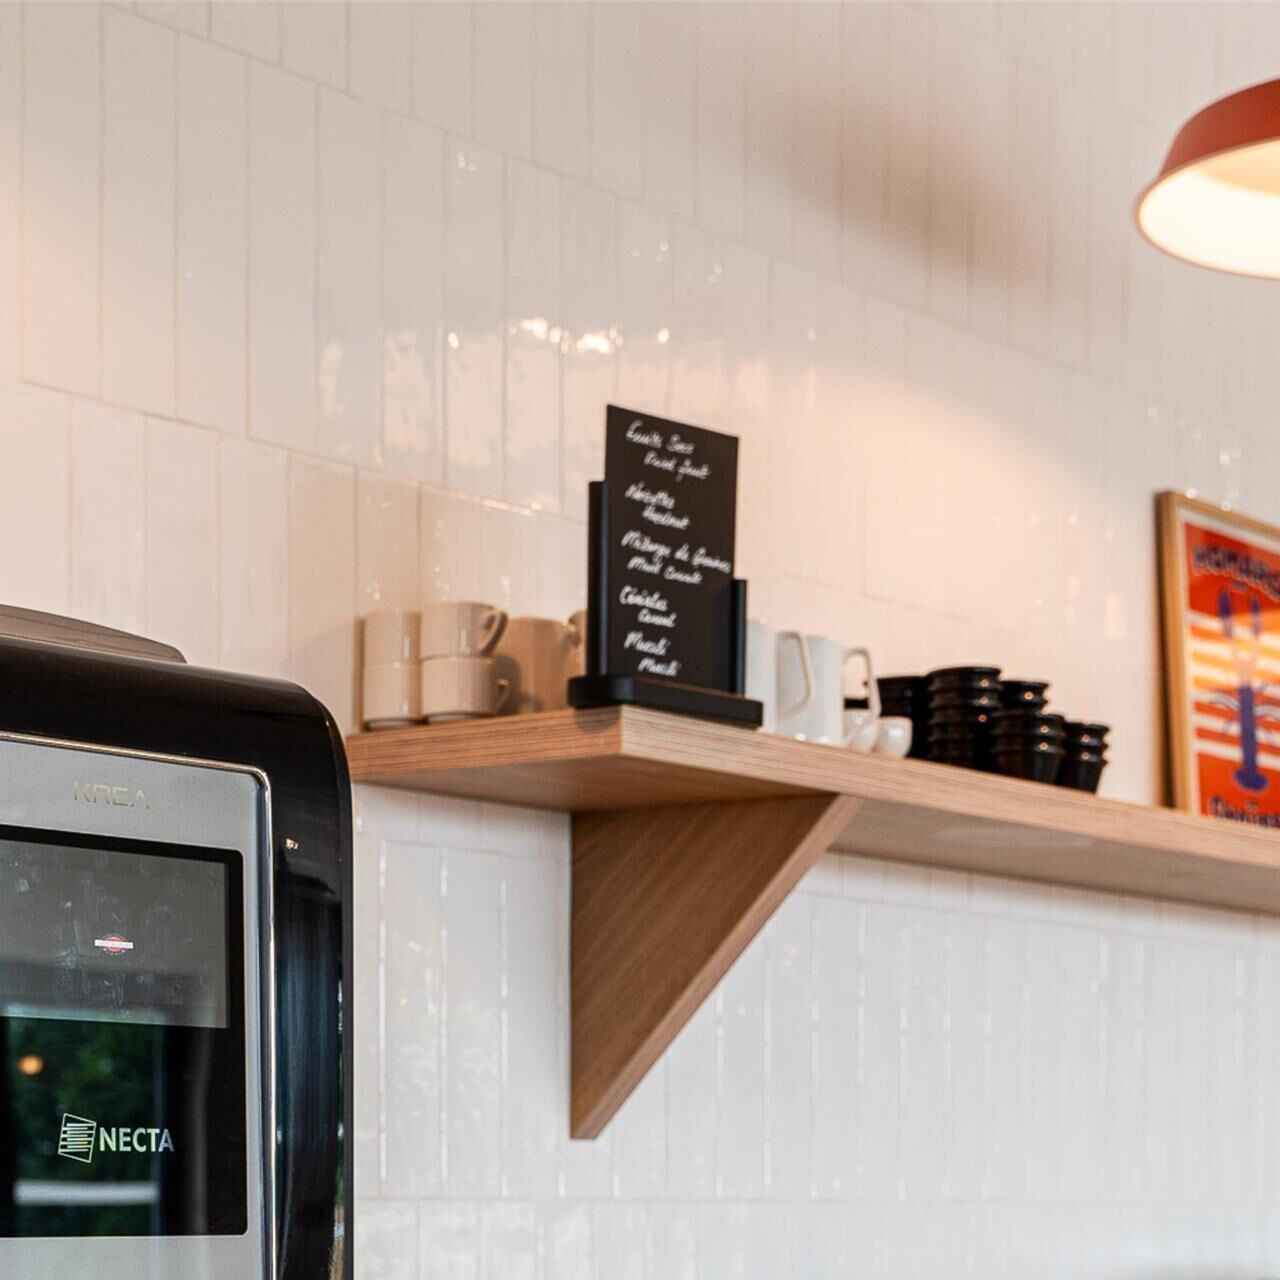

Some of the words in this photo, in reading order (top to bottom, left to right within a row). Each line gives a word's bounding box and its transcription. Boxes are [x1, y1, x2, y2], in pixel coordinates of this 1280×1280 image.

[674, 543, 690, 561] de
[73, 782, 151, 809] KREA
[98, 1127, 175, 1153] NECTA
